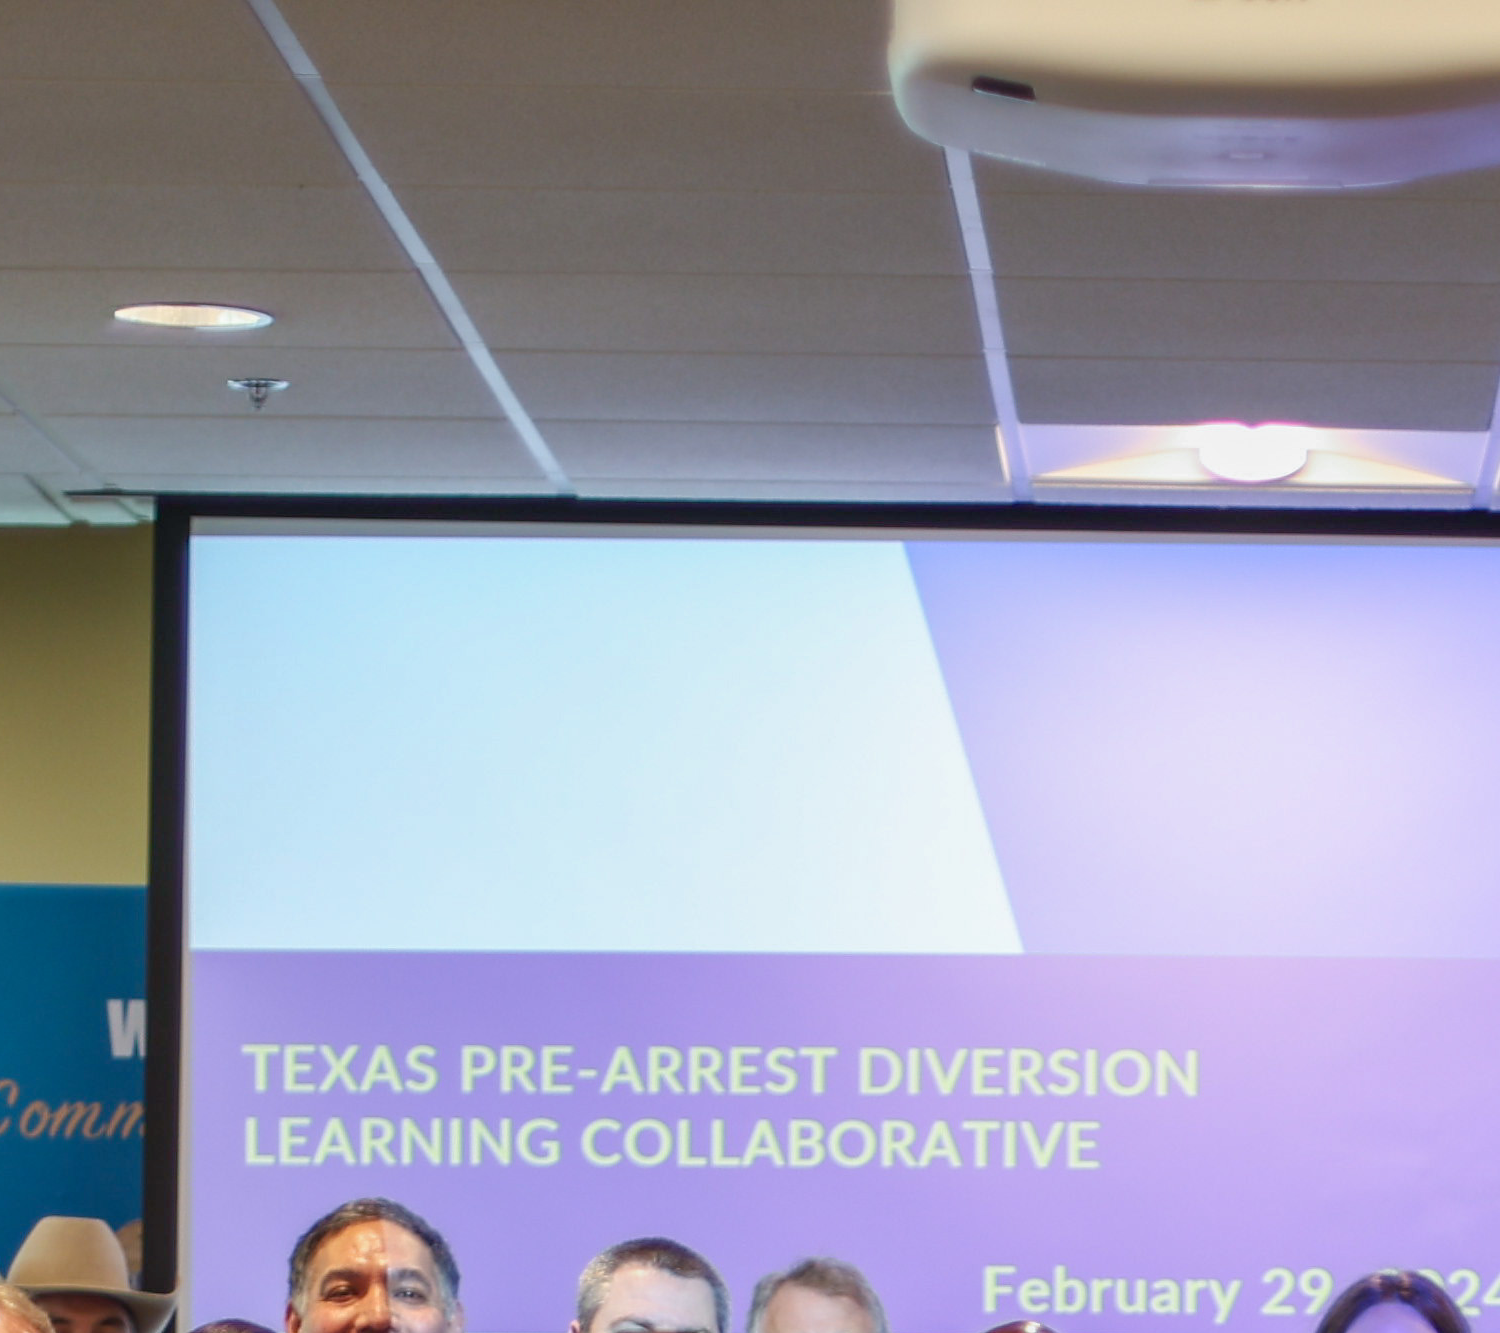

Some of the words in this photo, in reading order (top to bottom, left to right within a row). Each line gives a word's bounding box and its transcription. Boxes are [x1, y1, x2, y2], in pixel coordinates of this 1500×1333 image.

[242, 1043, 440, 1097] TEXAS
[460, 1045, 840, 1097] PRE-ARREST
[859, 1048, 1199, 1099] DIVERSION
[244, 1115, 561, 1170] LEARNING
[582, 1117, 1101, 1172] COLLABORATIVE
[982, 1265, 1241, 1324] February
